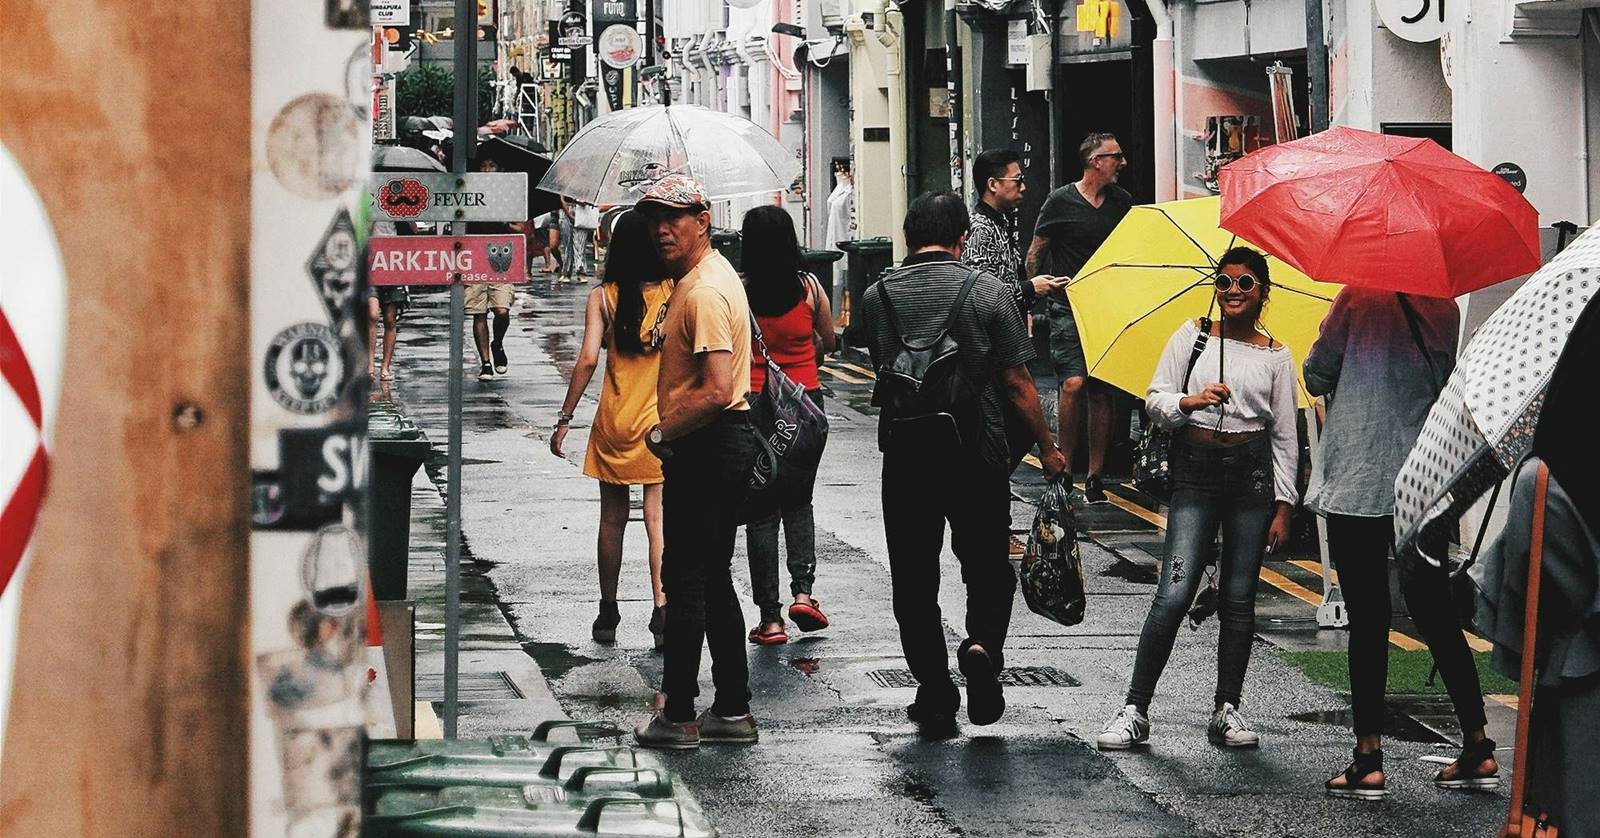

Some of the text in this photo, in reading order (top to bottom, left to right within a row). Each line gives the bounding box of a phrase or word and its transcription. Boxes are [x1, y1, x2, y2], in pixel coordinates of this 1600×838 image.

[1023, 142, 1032, 168] by
[433, 192, 487, 207] FEVER
[371, 250, 473, 271] ARKING
[446, 271, 507, 282] Pease...
